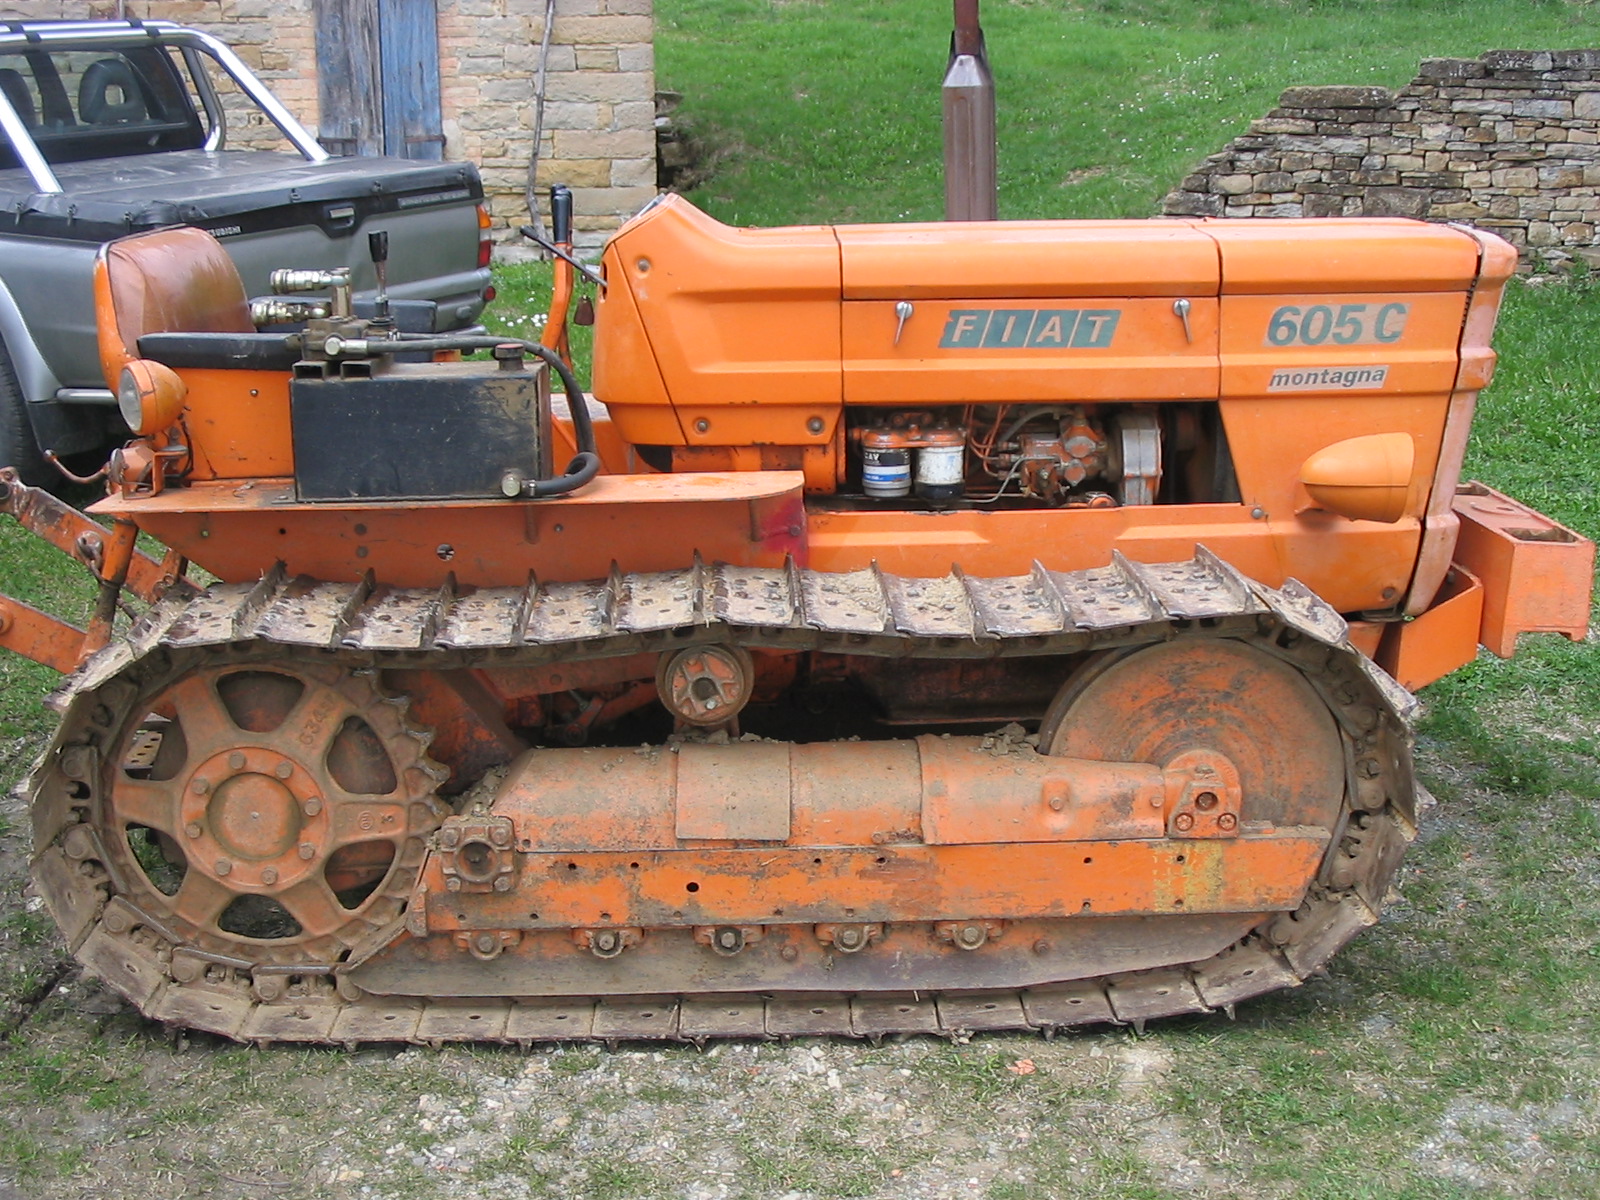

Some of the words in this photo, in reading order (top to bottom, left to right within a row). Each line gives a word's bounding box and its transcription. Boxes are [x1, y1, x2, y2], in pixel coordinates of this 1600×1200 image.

[951, 315, 1112, 343] FIAT
[1267, 304, 1367, 346] 605
[1374, 302, 1407, 344] C
[1269, 368, 1386, 388] montagna
